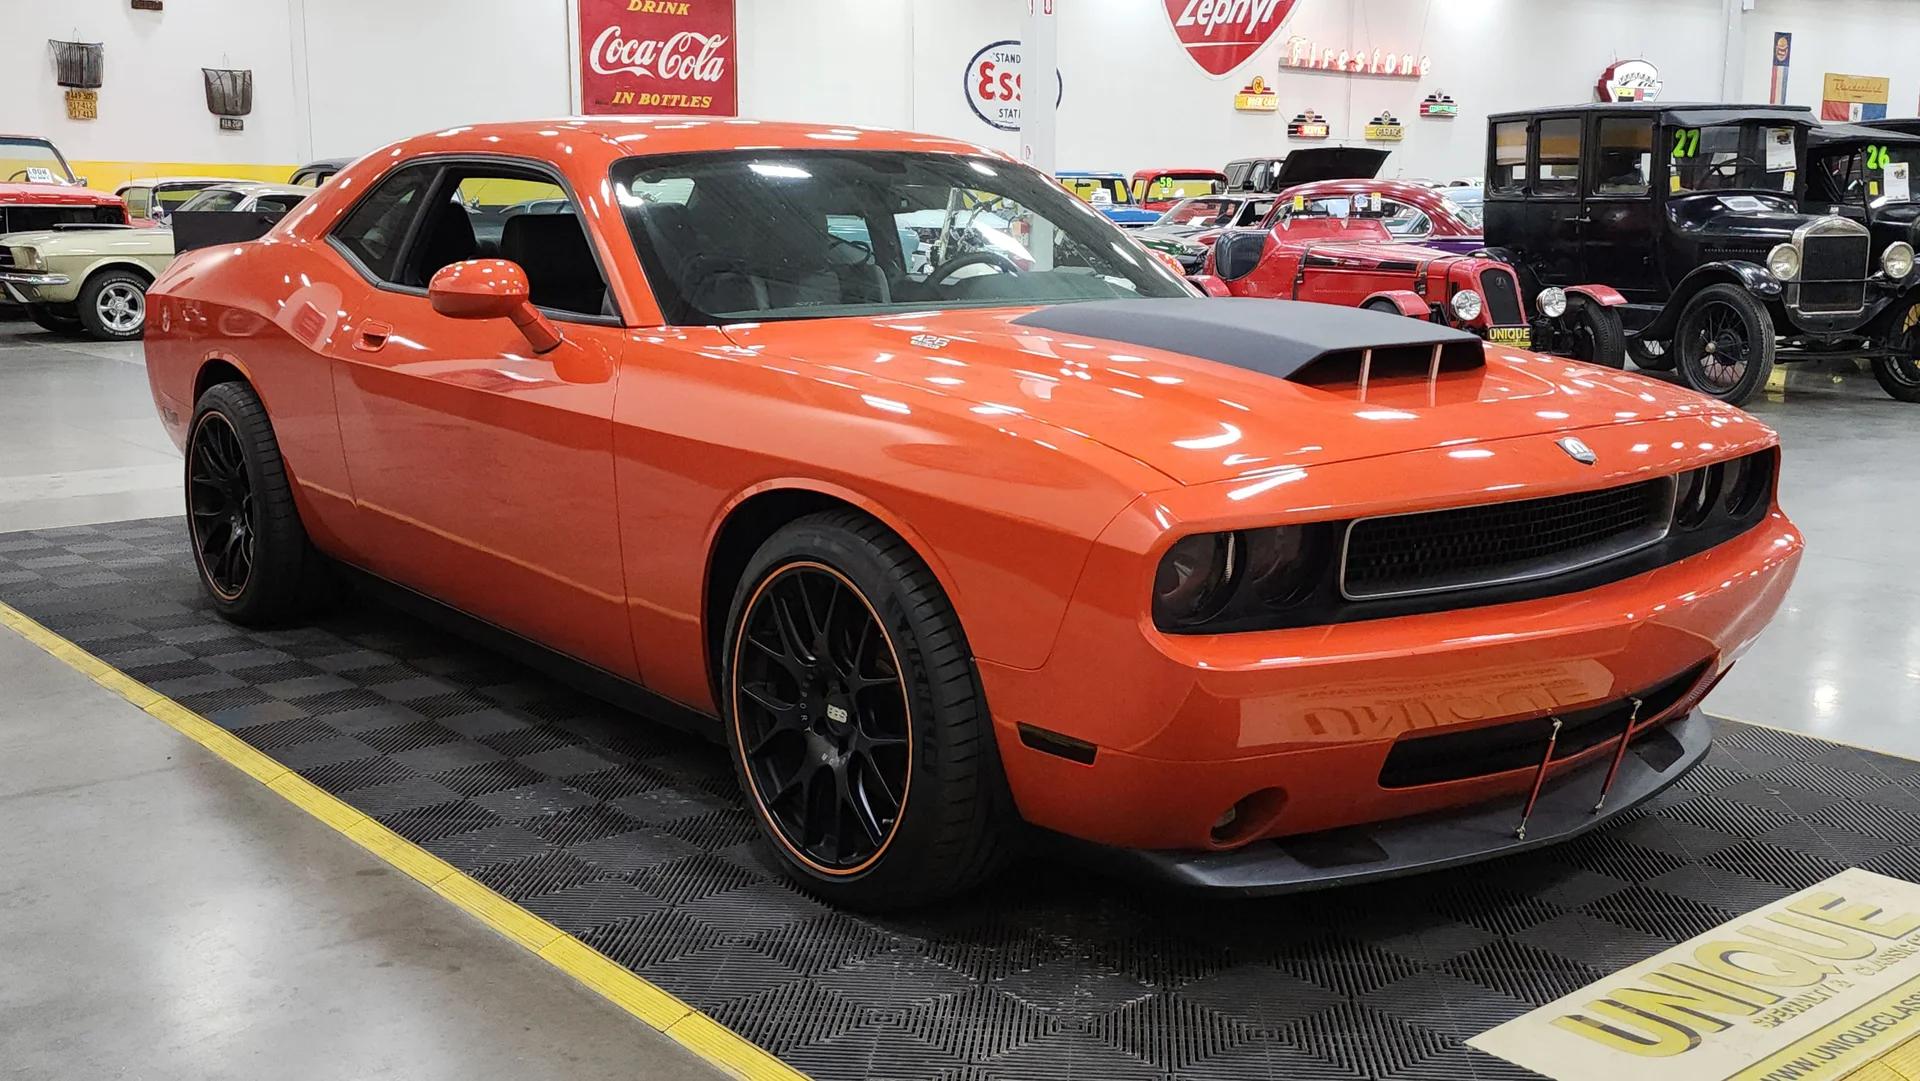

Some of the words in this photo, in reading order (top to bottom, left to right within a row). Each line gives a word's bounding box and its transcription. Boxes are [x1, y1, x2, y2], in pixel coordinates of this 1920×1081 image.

[627, 0, 691, 15] DRINK
[590, 25, 729, 82] Coca-Cola
[1287, 36, 1431, 75] Firestone
[612, 91, 635, 104] IN
[638, 93, 713, 108] BOTTLES
[1672, 128, 1700, 158] 27
[1866, 145, 1890, 170] 26
[1160, 176, 1173, 188] 58
[911, 334, 950, 347] 425
[1489, 327, 1531, 341] UNIQUE
[1550, 891, 1920, 1058] UNIQUE
